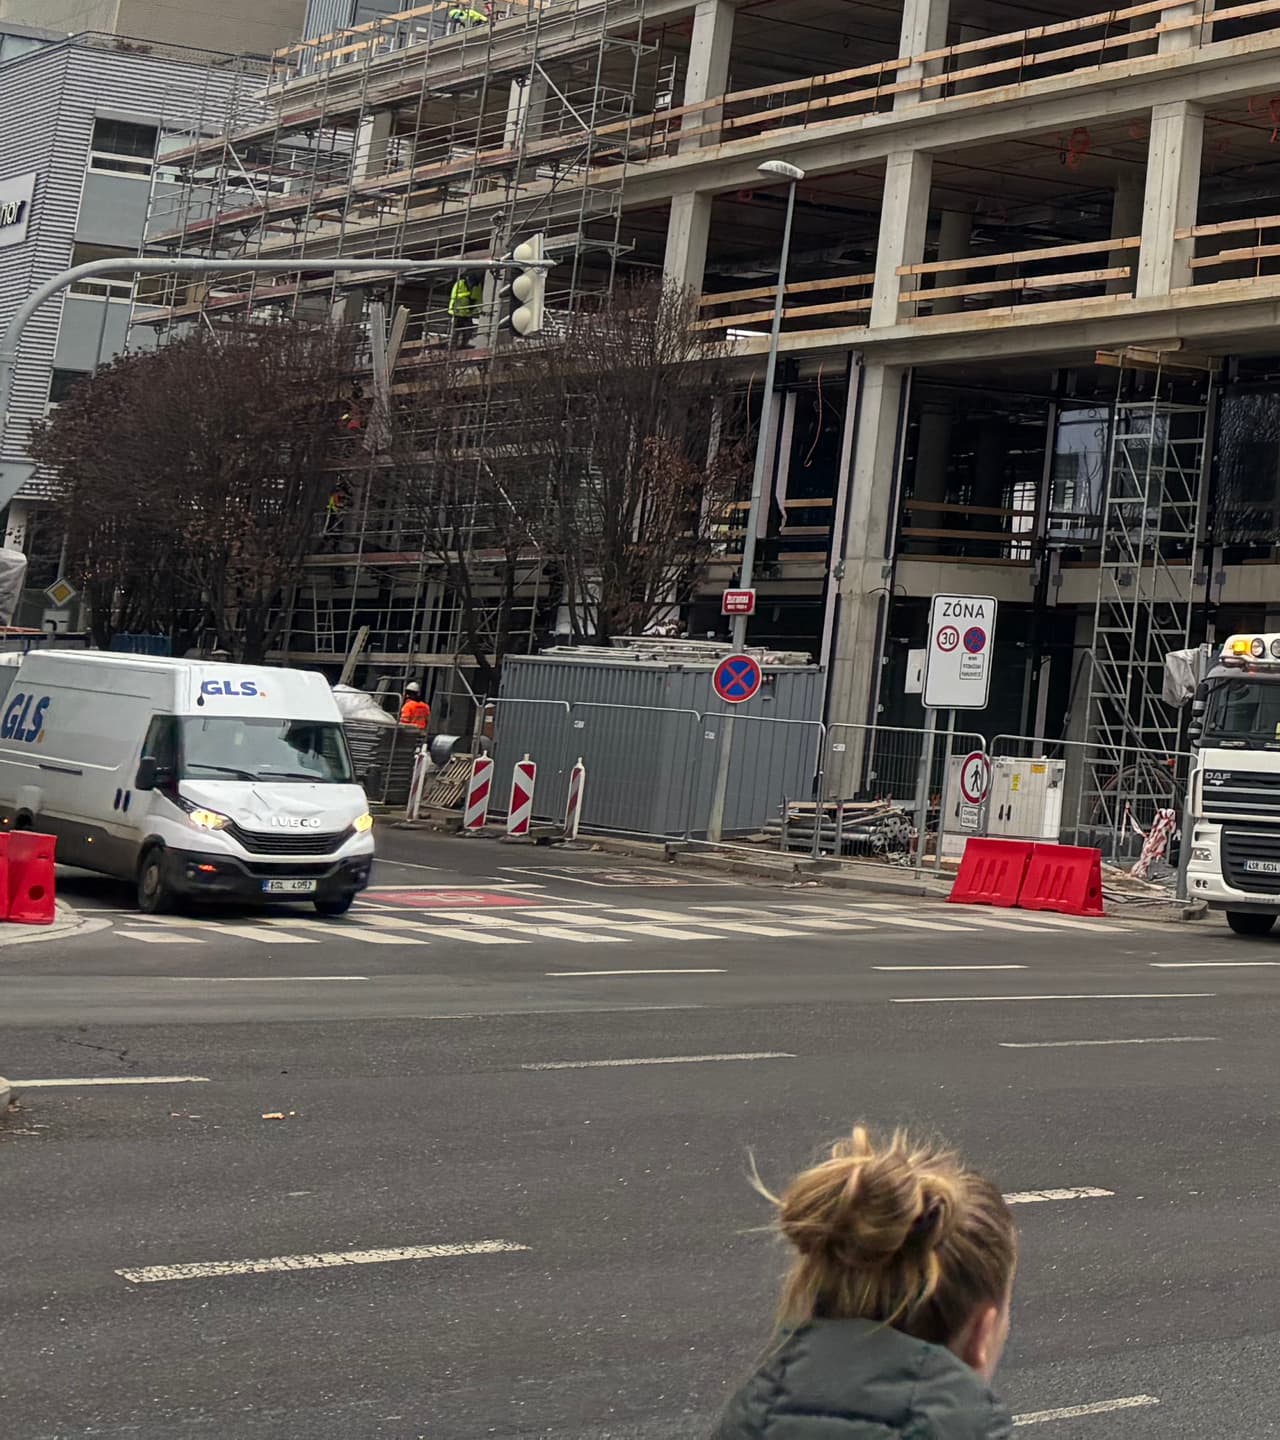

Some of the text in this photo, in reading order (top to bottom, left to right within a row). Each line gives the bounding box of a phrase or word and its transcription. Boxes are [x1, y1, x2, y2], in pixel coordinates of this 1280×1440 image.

[942, 600, 985, 619] ZÓNA
[941, 632, 956, 645] 30
[271, 816, 321, 828] IVECO
